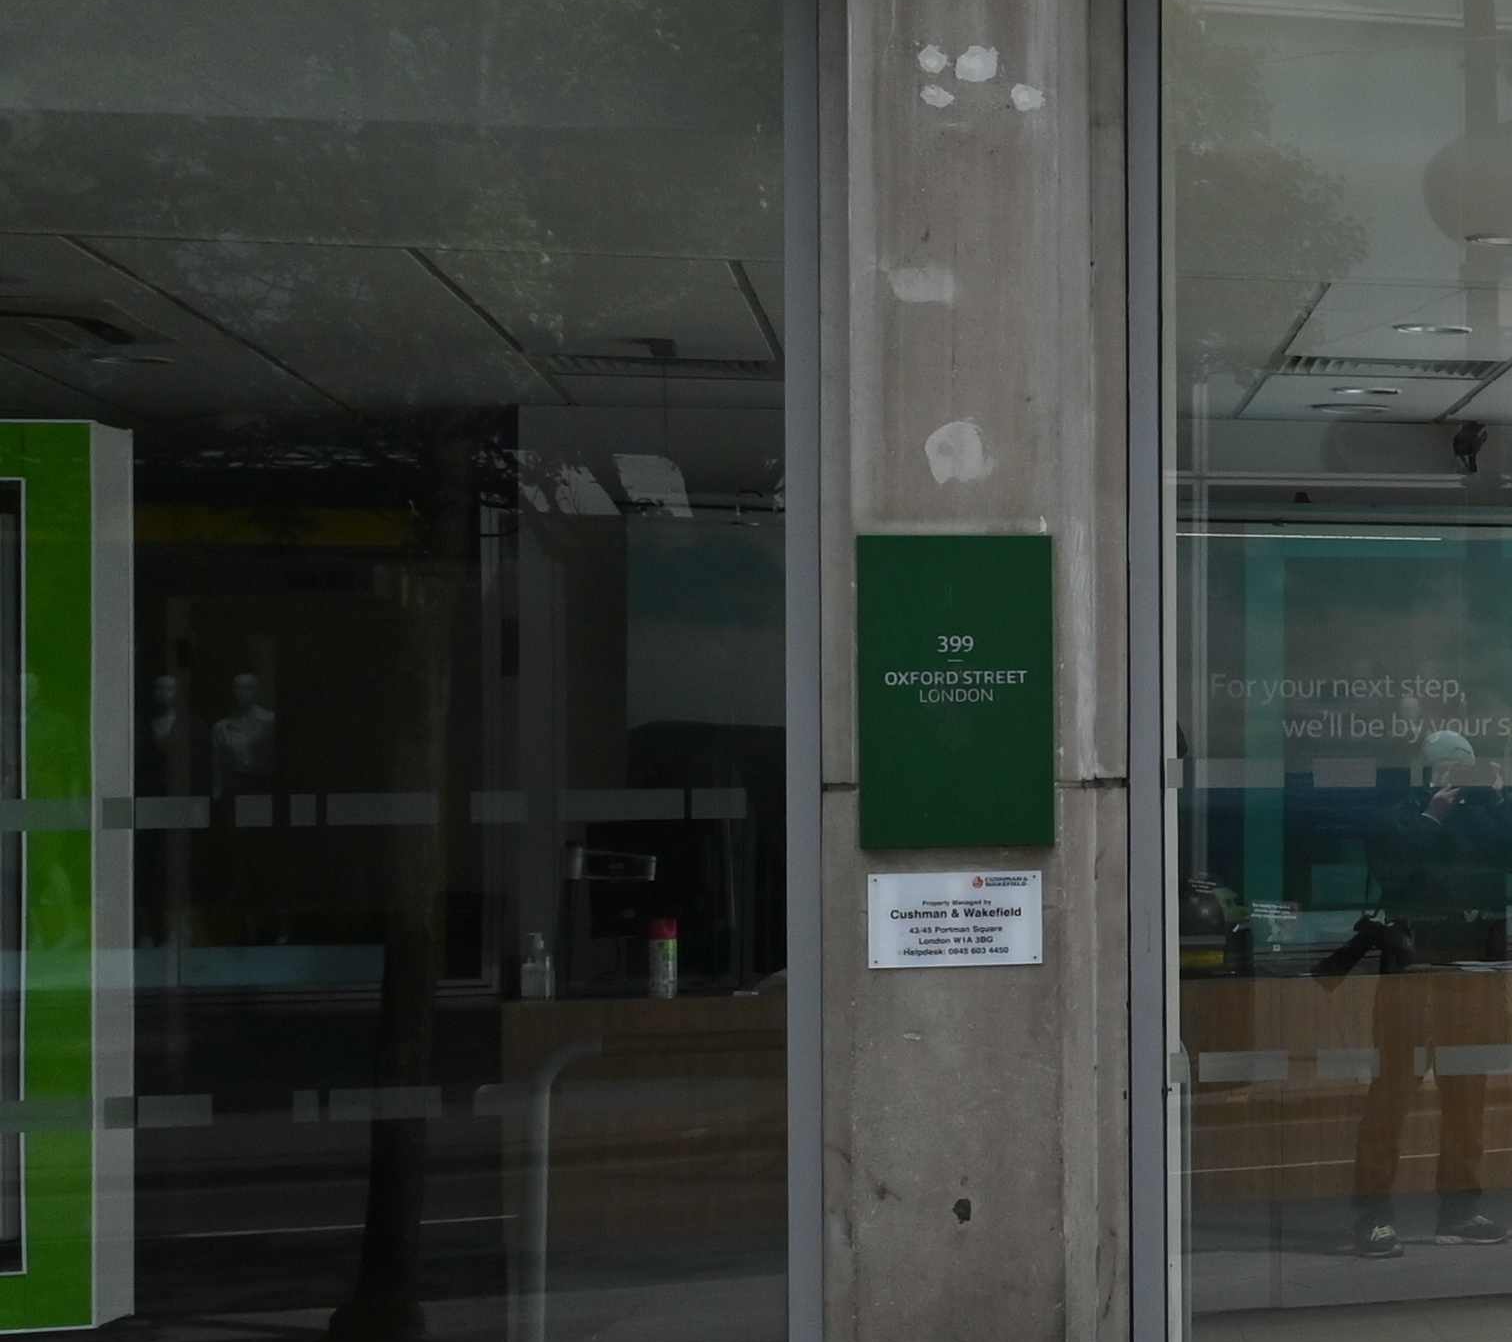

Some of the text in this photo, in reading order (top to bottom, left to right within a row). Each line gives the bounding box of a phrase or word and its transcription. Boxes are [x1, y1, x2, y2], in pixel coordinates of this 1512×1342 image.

[937, 635, 974, 652] 399
[884, 670, 1028, 685] OXFORD STREET
[919, 688, 994, 703] LONDON
[1210, 674, 1466, 705] For your next step,
[1282, 713, 1343, 738] we'll
[1351, 713, 1385, 738] be
[1392, 712, 1423, 743] by
[1430, 715, 1492, 739] your
[890, 907, 1022, 920] Cushman & Wakefield
[973, 925, 1003, 934] Square
[918, 937, 950, 945] London
